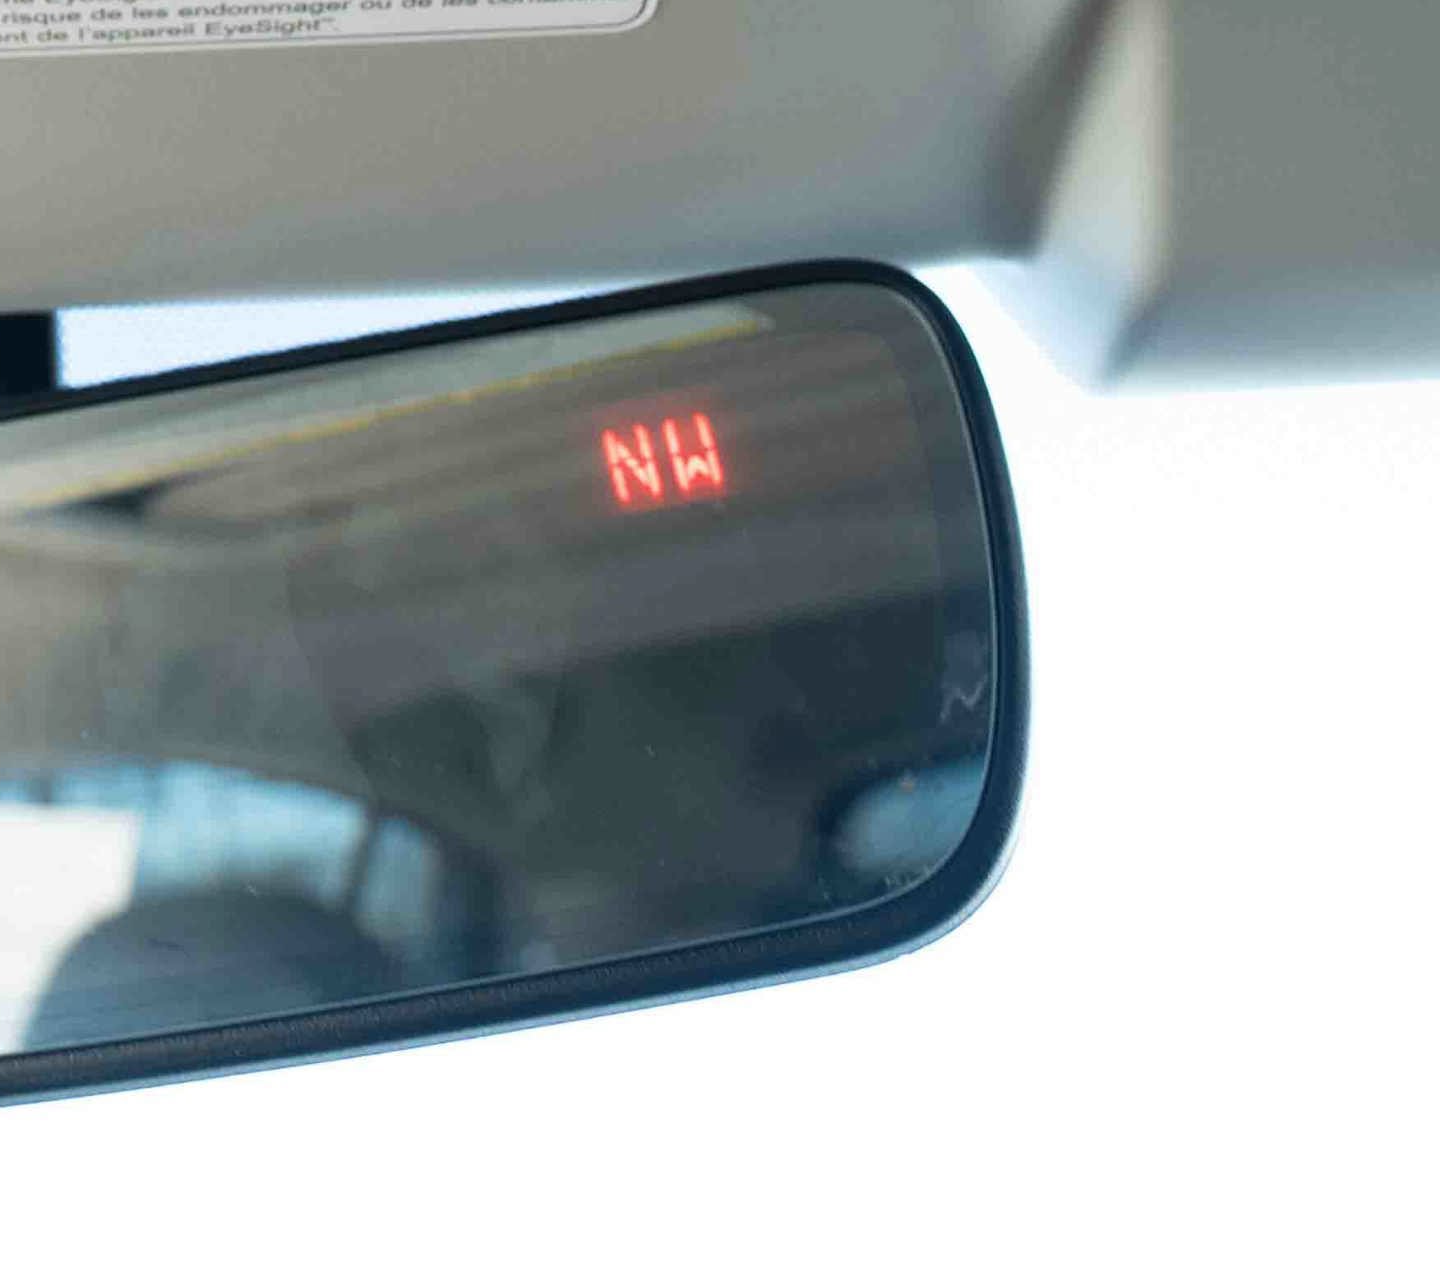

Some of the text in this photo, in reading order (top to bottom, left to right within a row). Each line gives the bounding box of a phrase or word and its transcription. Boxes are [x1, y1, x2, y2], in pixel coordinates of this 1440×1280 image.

[1, 8, 82, 25] risque
[90, 7, 123, 21] de
[600, 410, 725, 505] NW
